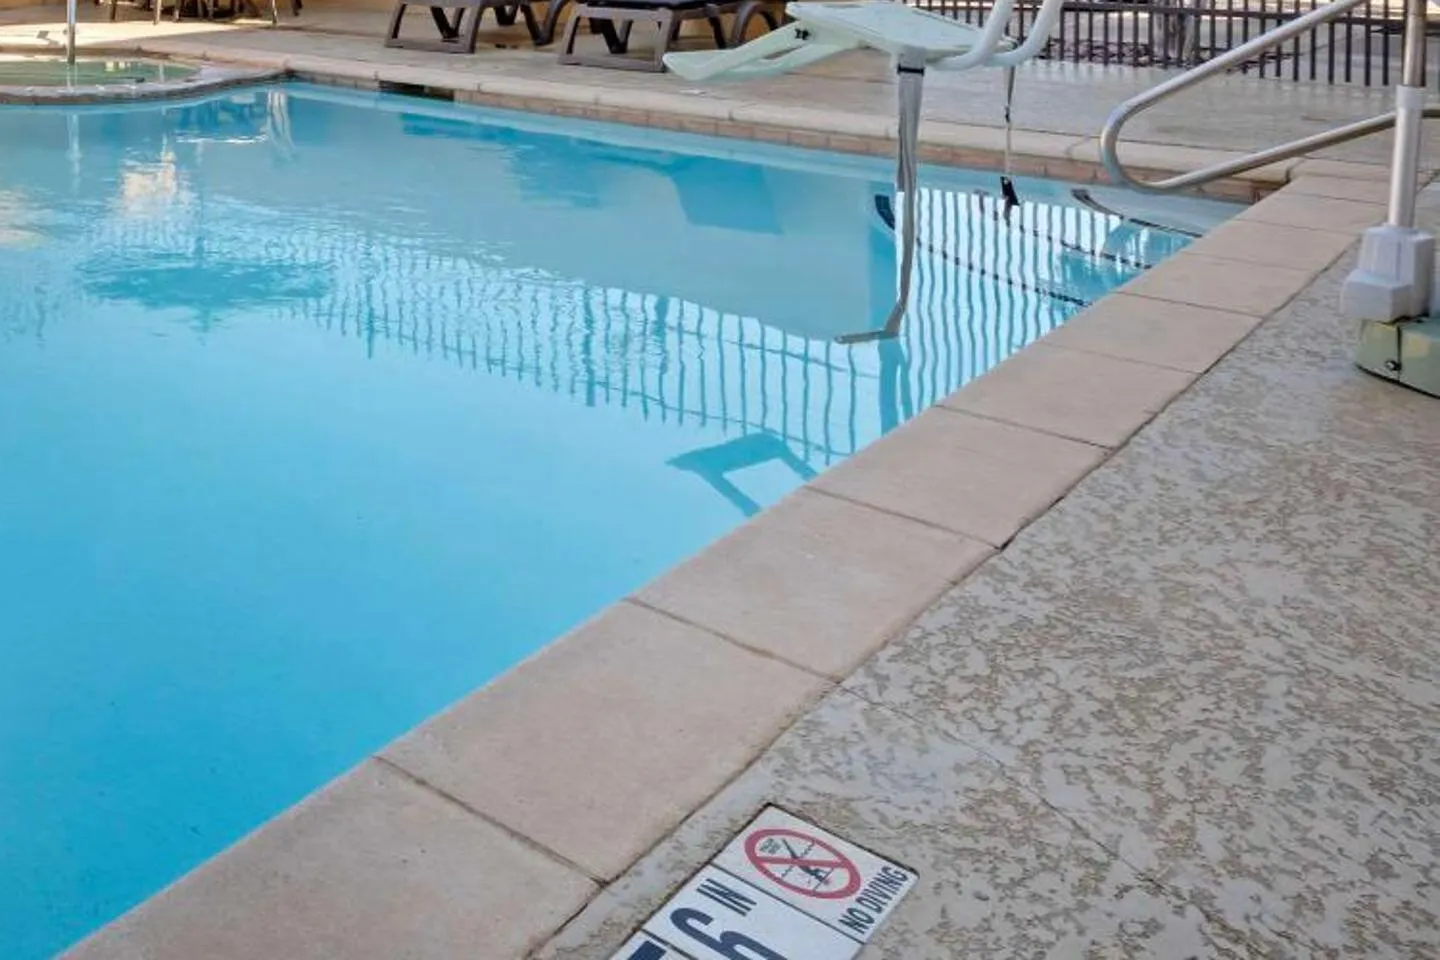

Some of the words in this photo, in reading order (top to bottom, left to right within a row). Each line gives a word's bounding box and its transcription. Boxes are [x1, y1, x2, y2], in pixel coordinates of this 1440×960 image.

[696, 878, 757, 917] IN
[855, 865, 909, 914] DIVING
[837, 907, 875, 935] NO
